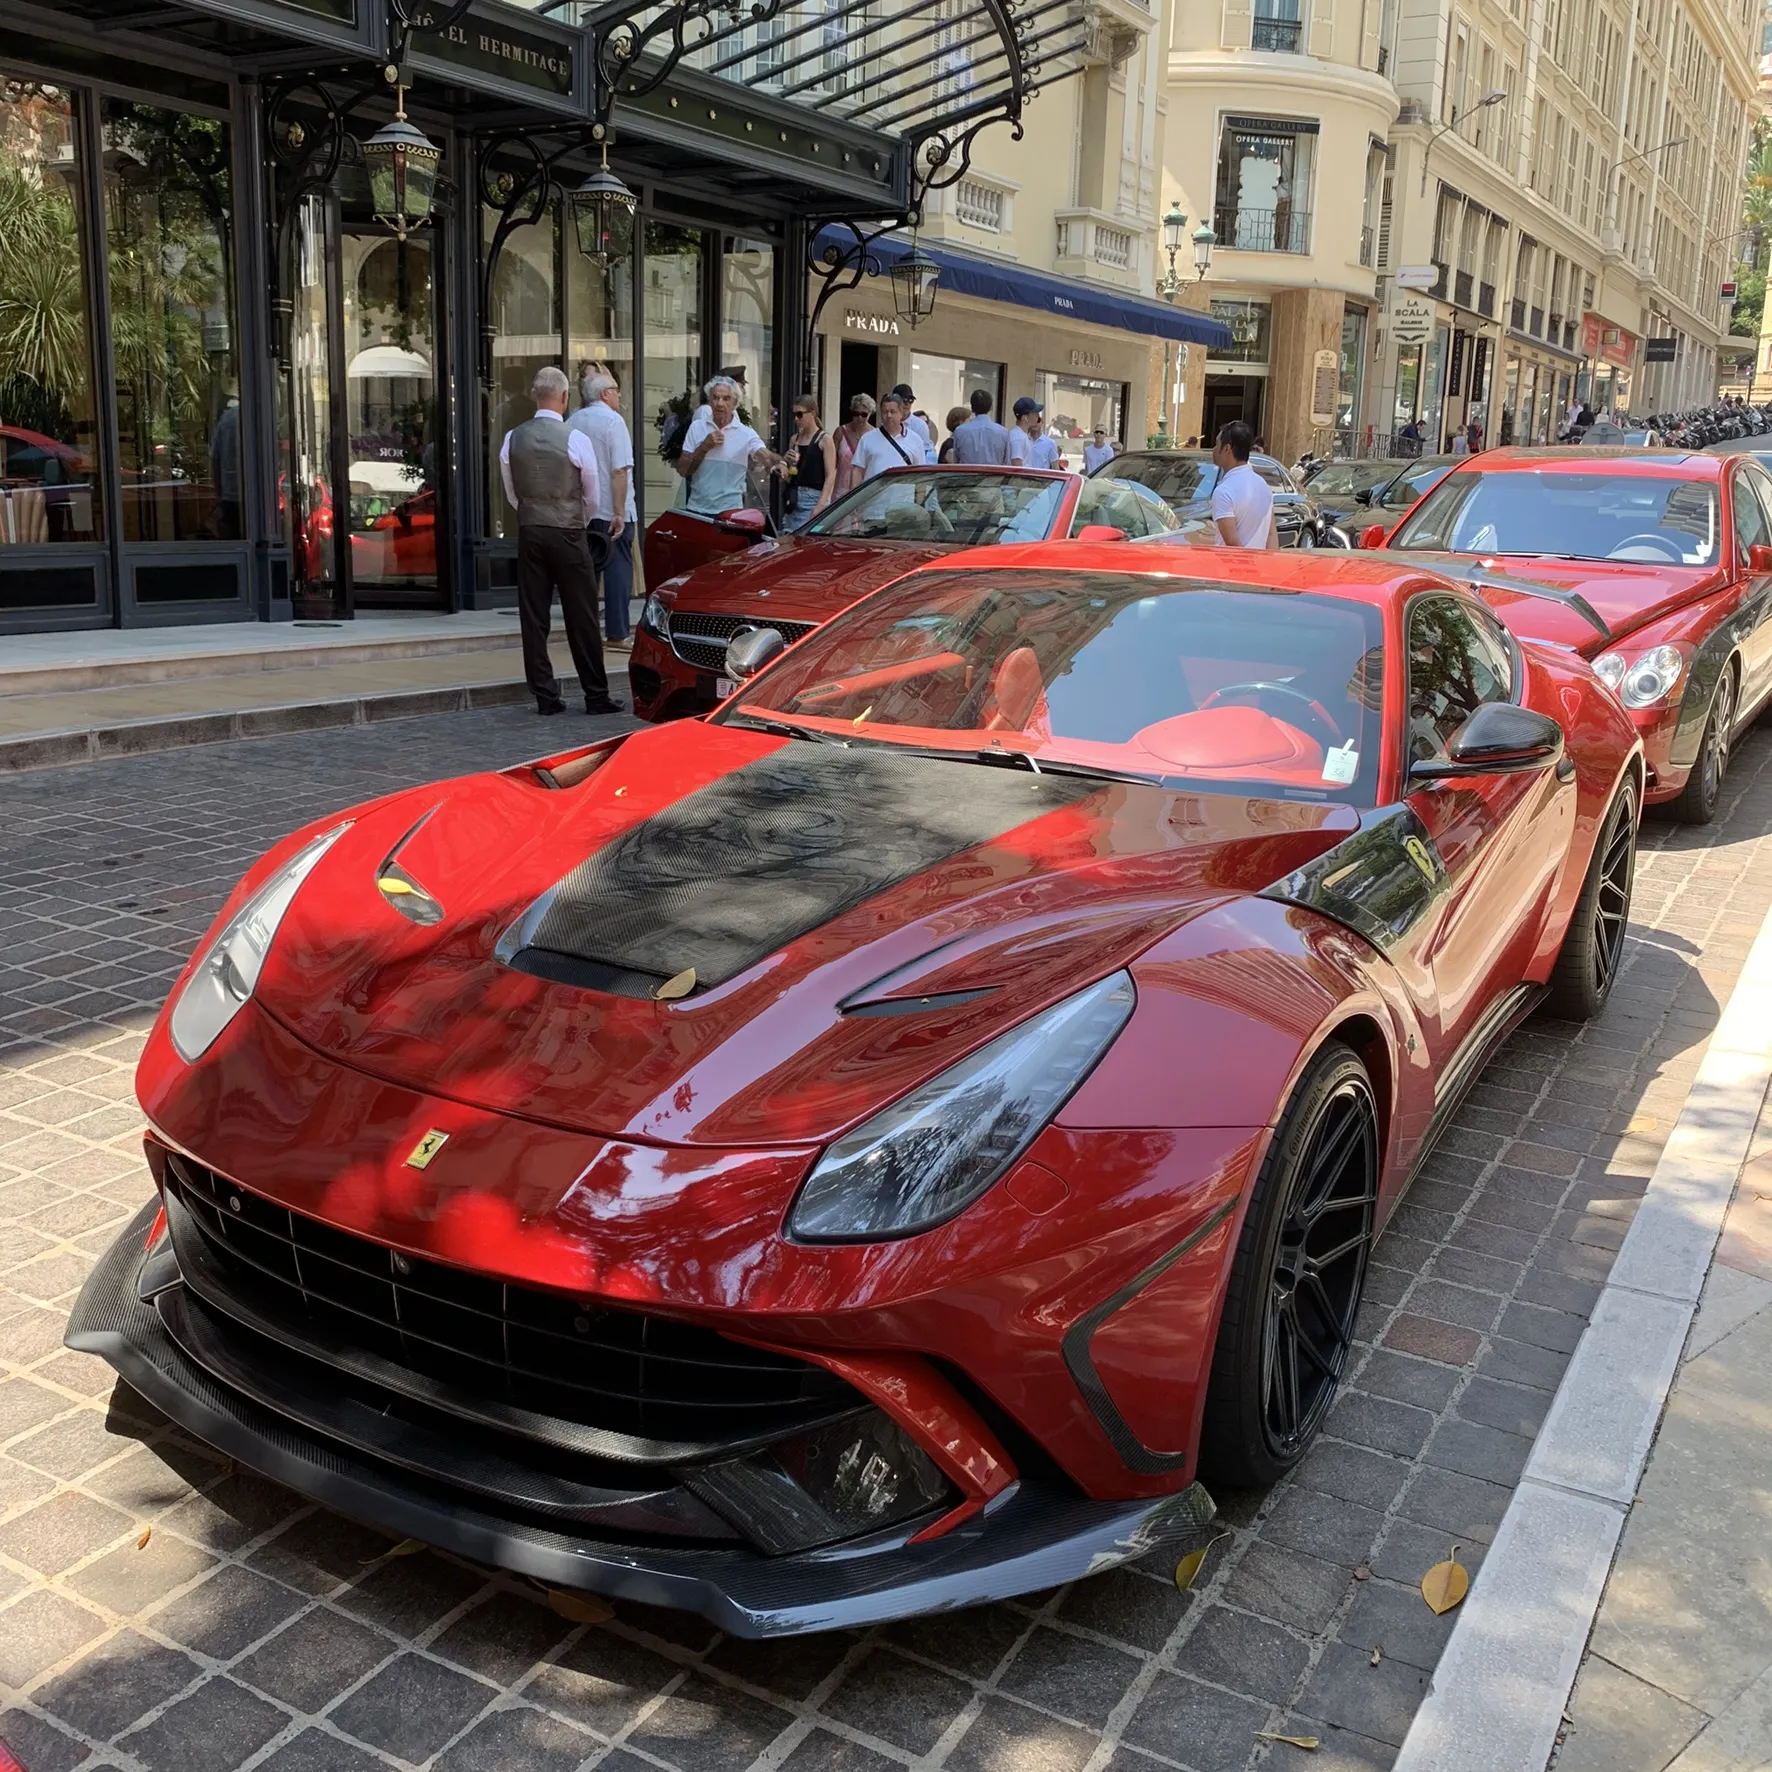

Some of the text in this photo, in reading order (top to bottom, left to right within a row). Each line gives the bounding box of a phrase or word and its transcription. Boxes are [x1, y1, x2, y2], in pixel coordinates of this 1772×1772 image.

[479, 34, 567, 76] HERMITAGE
[1239, 119, 1307, 132] OPERA GALLERY
[1235, 134, 1295, 146] OPERA GALLERY
[1054, 296, 1074, 310] PRADA
[1407, 299, 1419, 307] LA
[1210, 305, 1260, 319] PALAIS
[1395, 308, 1430, 317] SCALA
[845, 310, 900, 335] PRADA
[1235, 320, 1249, 329] LA
[1070, 350, 1105, 370] PRADA
[1288, 1091, 1321, 1157] Continental
